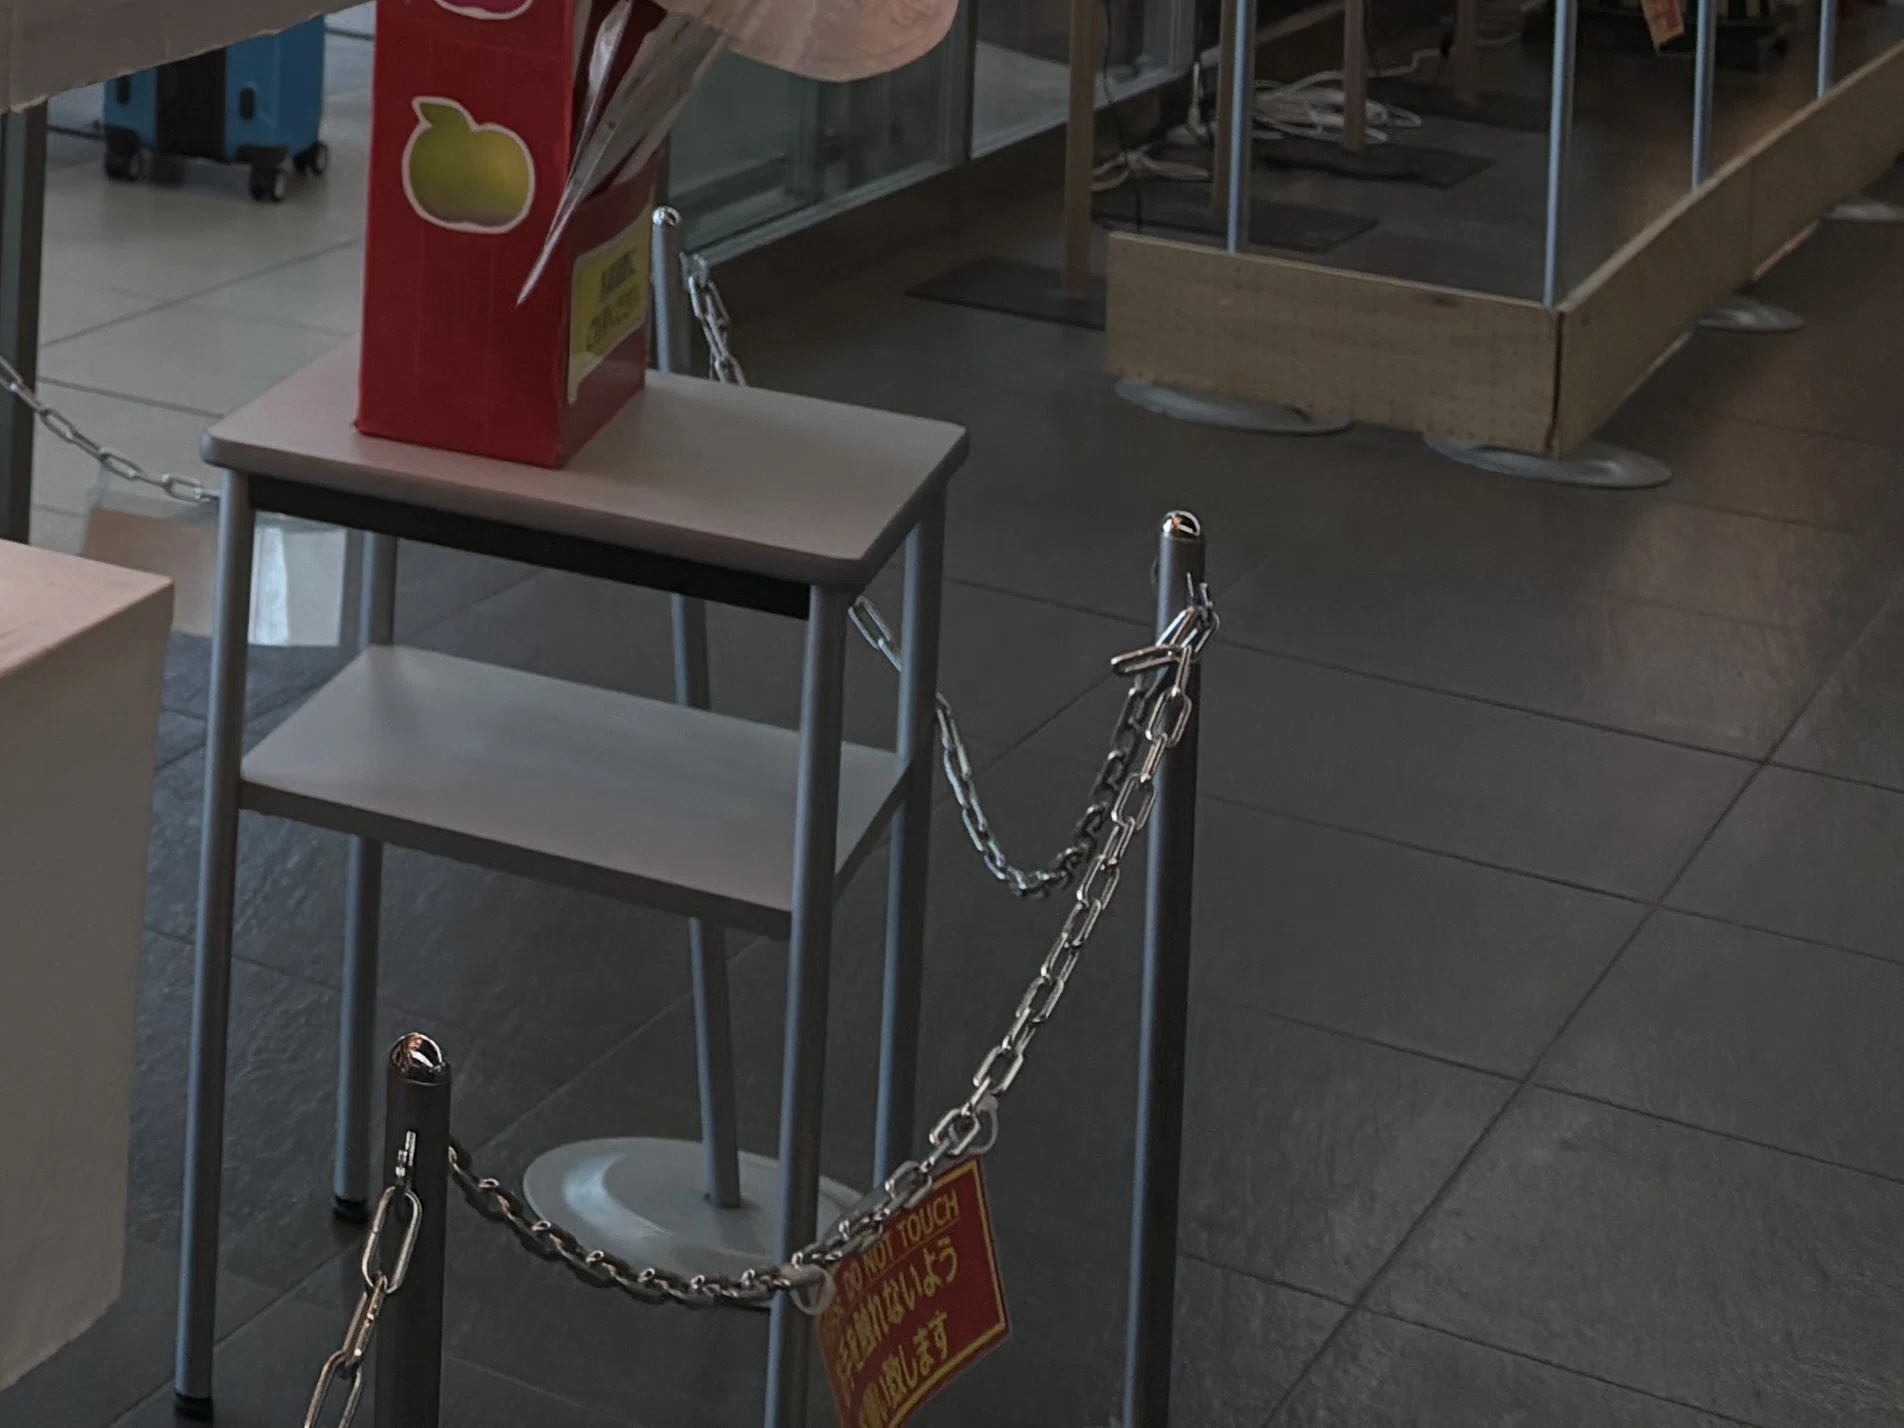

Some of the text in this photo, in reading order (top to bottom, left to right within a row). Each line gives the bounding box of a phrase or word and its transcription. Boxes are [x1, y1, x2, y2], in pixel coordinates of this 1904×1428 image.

[843, 1188, 960, 1300] DO NOT TOUCH
